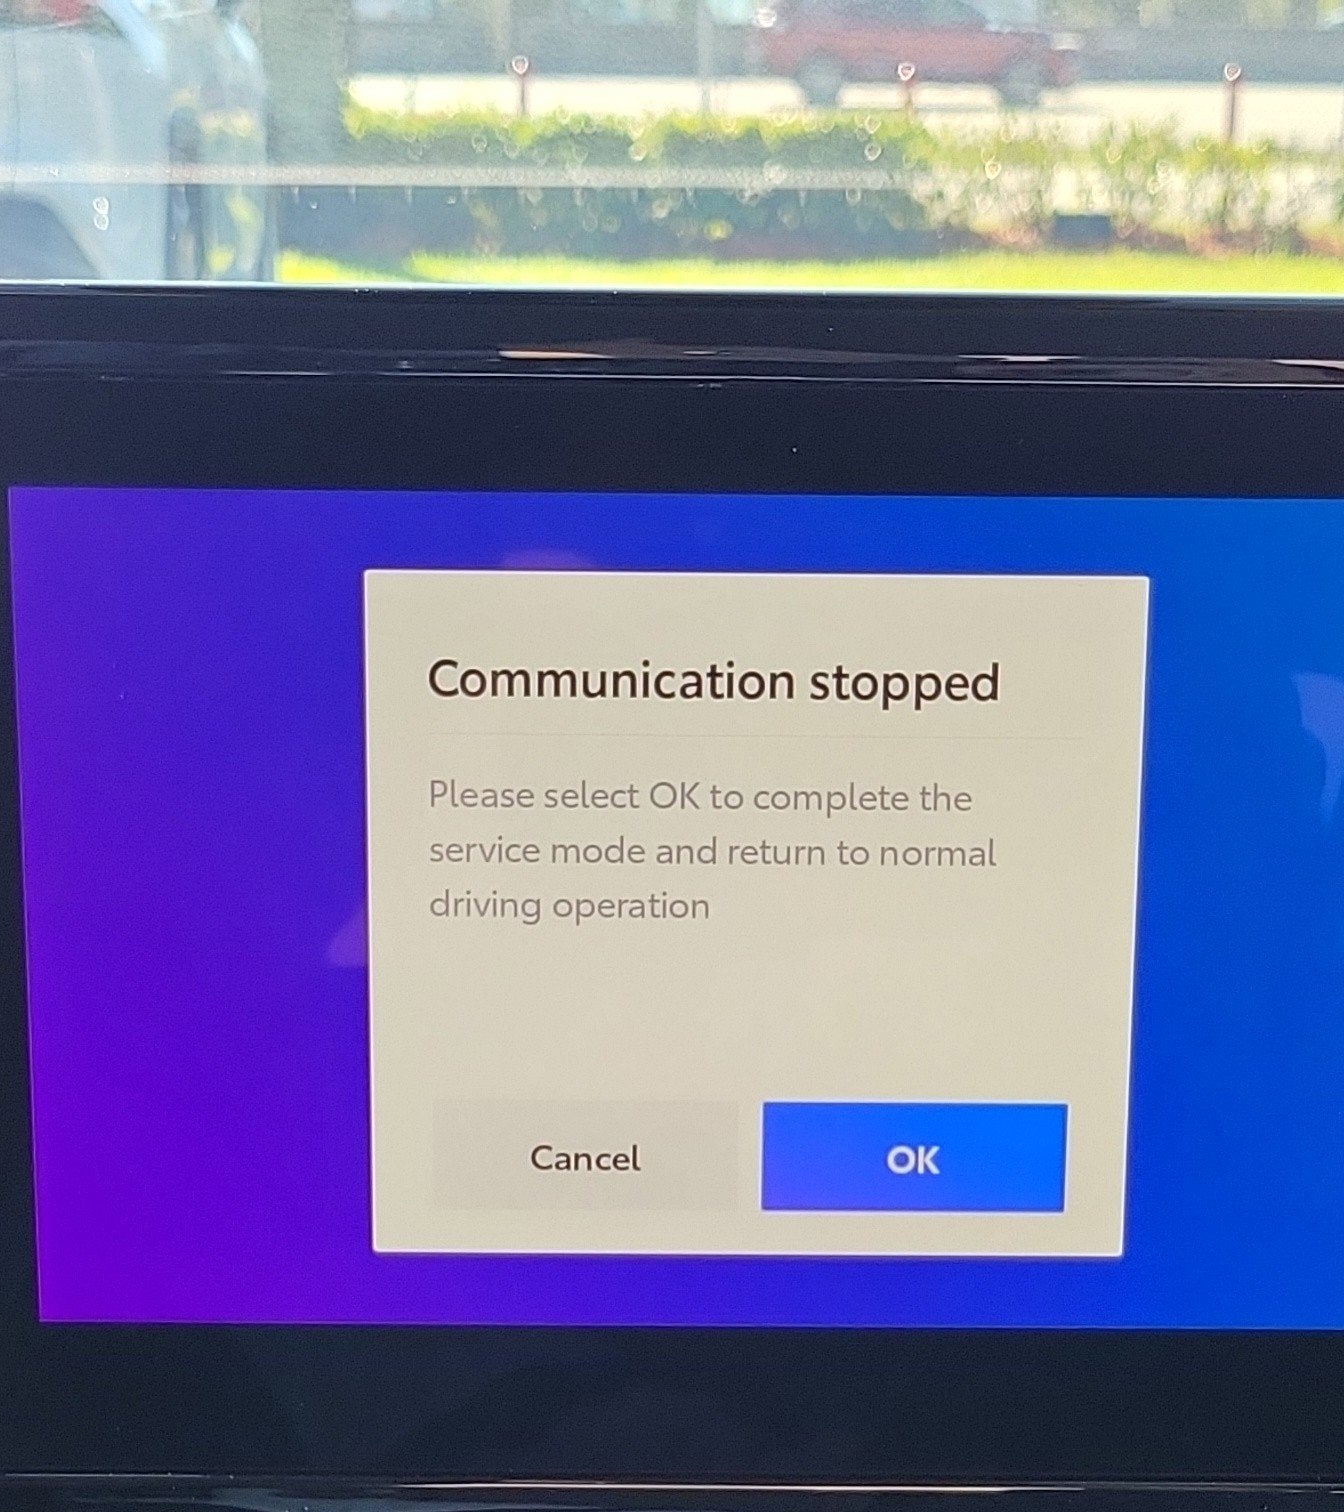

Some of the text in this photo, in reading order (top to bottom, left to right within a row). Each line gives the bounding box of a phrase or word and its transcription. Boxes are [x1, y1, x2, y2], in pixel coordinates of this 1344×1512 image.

[428, 659, 999, 711] Communication stopped
[430, 778, 973, 819] Please select OK to complete the
[429, 834, 997, 867] service mode and return to normal
[429, 888, 710, 926] driving operation
[530, 1144, 641, 1172] Cancel
[887, 1145, 940, 1174] OK
